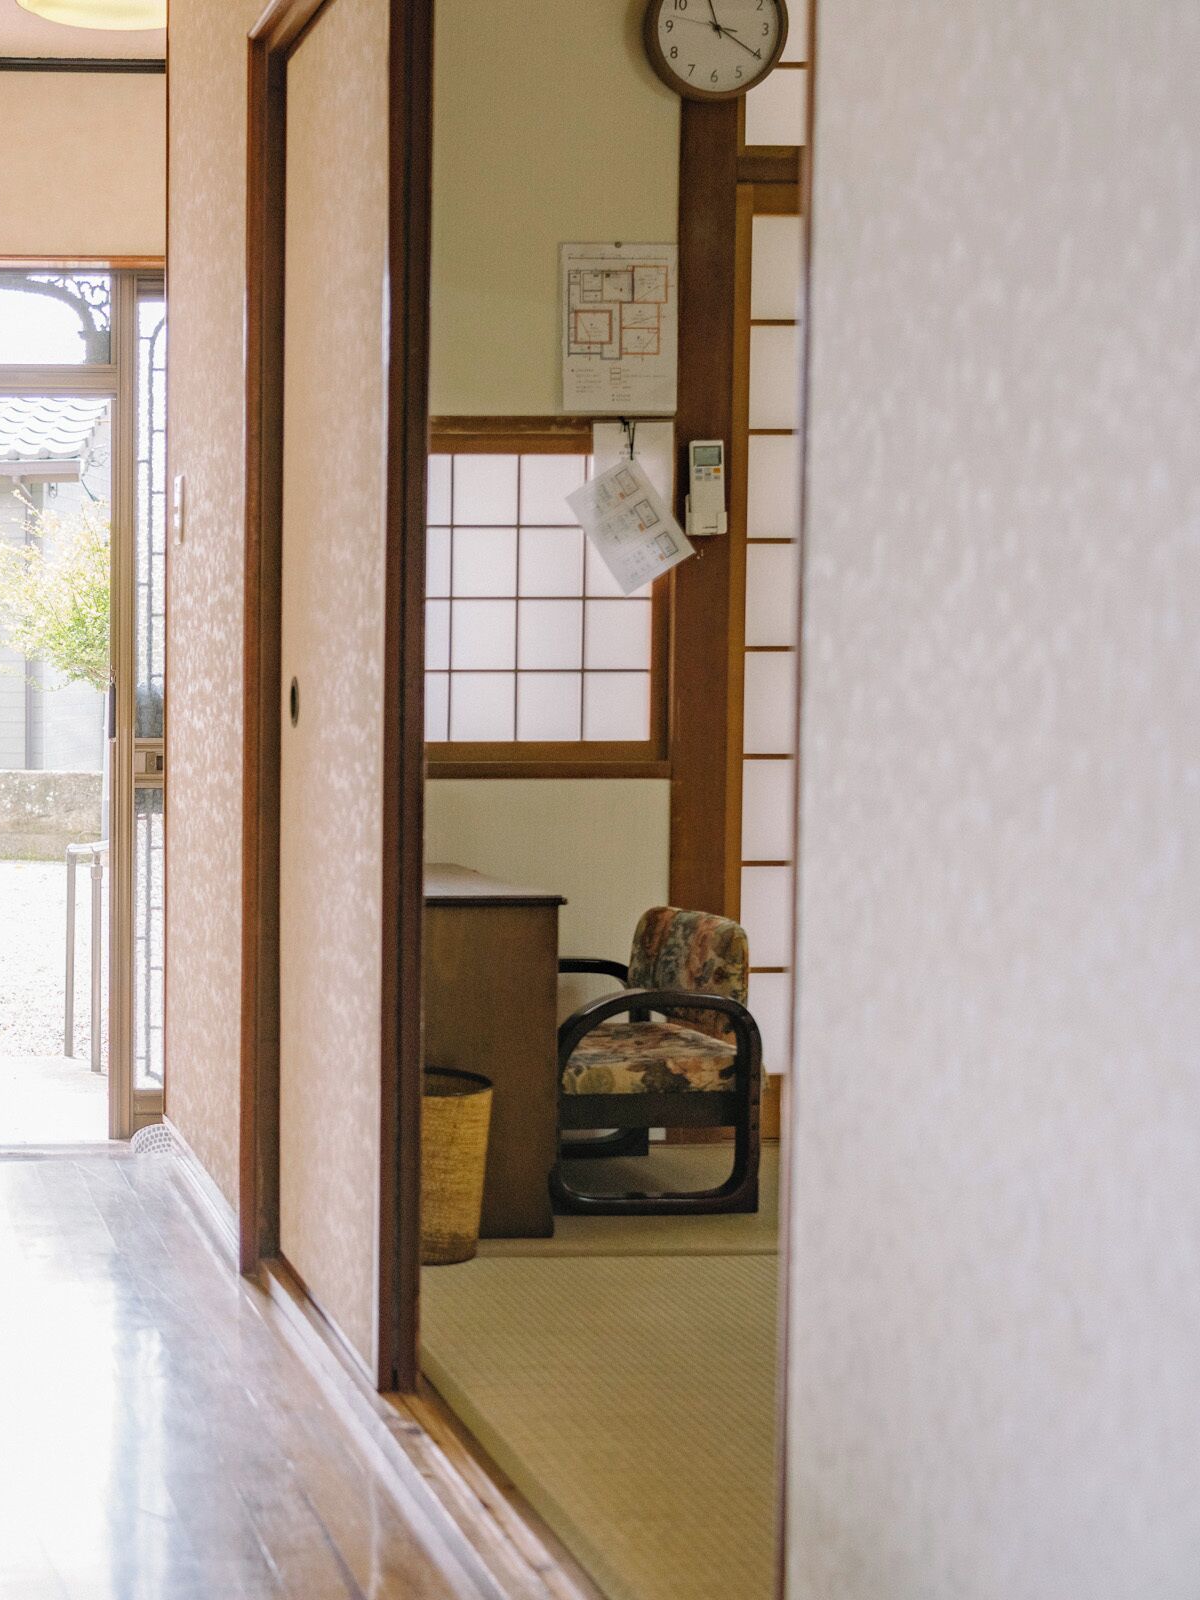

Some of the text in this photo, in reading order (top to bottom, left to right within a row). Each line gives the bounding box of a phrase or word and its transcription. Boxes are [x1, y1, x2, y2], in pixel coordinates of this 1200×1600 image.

[665, 20, 673, 33] 9
[761, 23, 769, 36] 3
[670, 46, 678, 59] 8
[753, 48, 761, 59] 4
[688, 64, 696, 77] 7
[710, 69, 718, 83] 6
[735, 66, 743, 79] 5
